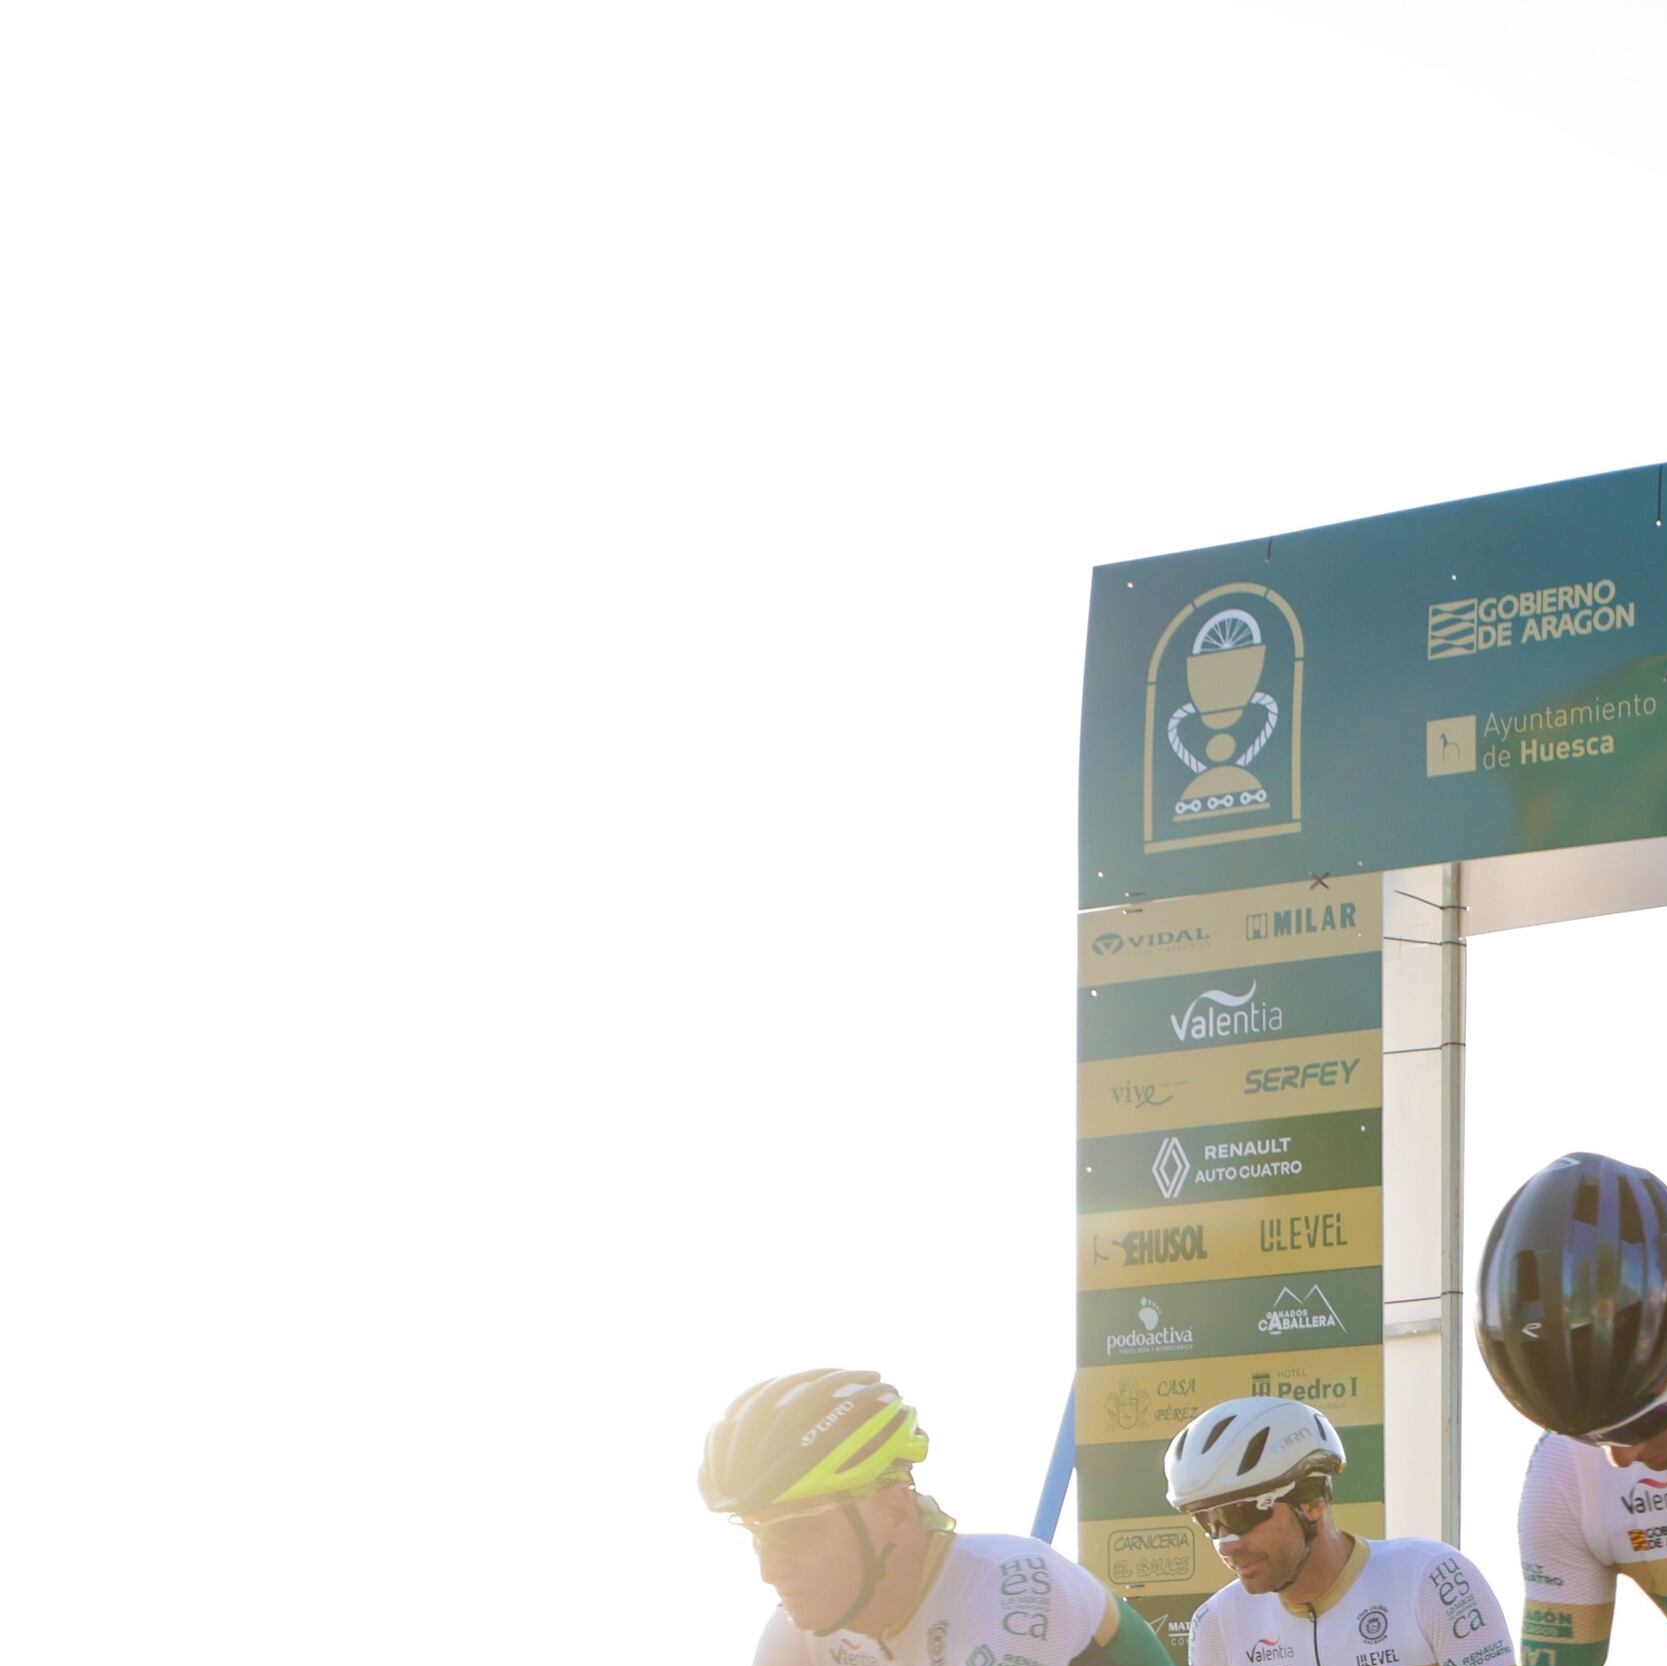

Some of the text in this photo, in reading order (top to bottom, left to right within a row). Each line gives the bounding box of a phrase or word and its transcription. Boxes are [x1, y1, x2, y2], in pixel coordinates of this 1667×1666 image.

[1478, 579, 1616, 623] GOBIERNO
[1478, 602, 1635, 650] DE ARAGON
[1483, 694, 1657, 742] Ayuntamiento
[1483, 735, 1614, 770] de Huesca
[1273, 901, 1357, 938] MILAR
[1129, 928, 1211, 949] VIDAL
[1170, 988, 1283, 1042] Valentia
[1244, 1058, 1361, 1095] SERFEY
[1204, 1137, 1292, 1160] RENAULT
[1194, 1160, 1303, 1184] AUTO CUATRO
[1258, 1311, 1336, 1335] CABALLERA
[1107, 1325, 1193, 1356] podoactiva
[1277, 1368, 1308, 1378] HOTEL
[1157, 1378, 1197, 1397] CASA
[1277, 1377, 1358, 1400] Pedro I
[1647, 1535, 1665, 1549] DE
[1168, 1621, 1191, 1632] MAT
[1246, 1641, 1294, 1664] Valentia
[1462, 1640, 1504, 1665] RENAULT
